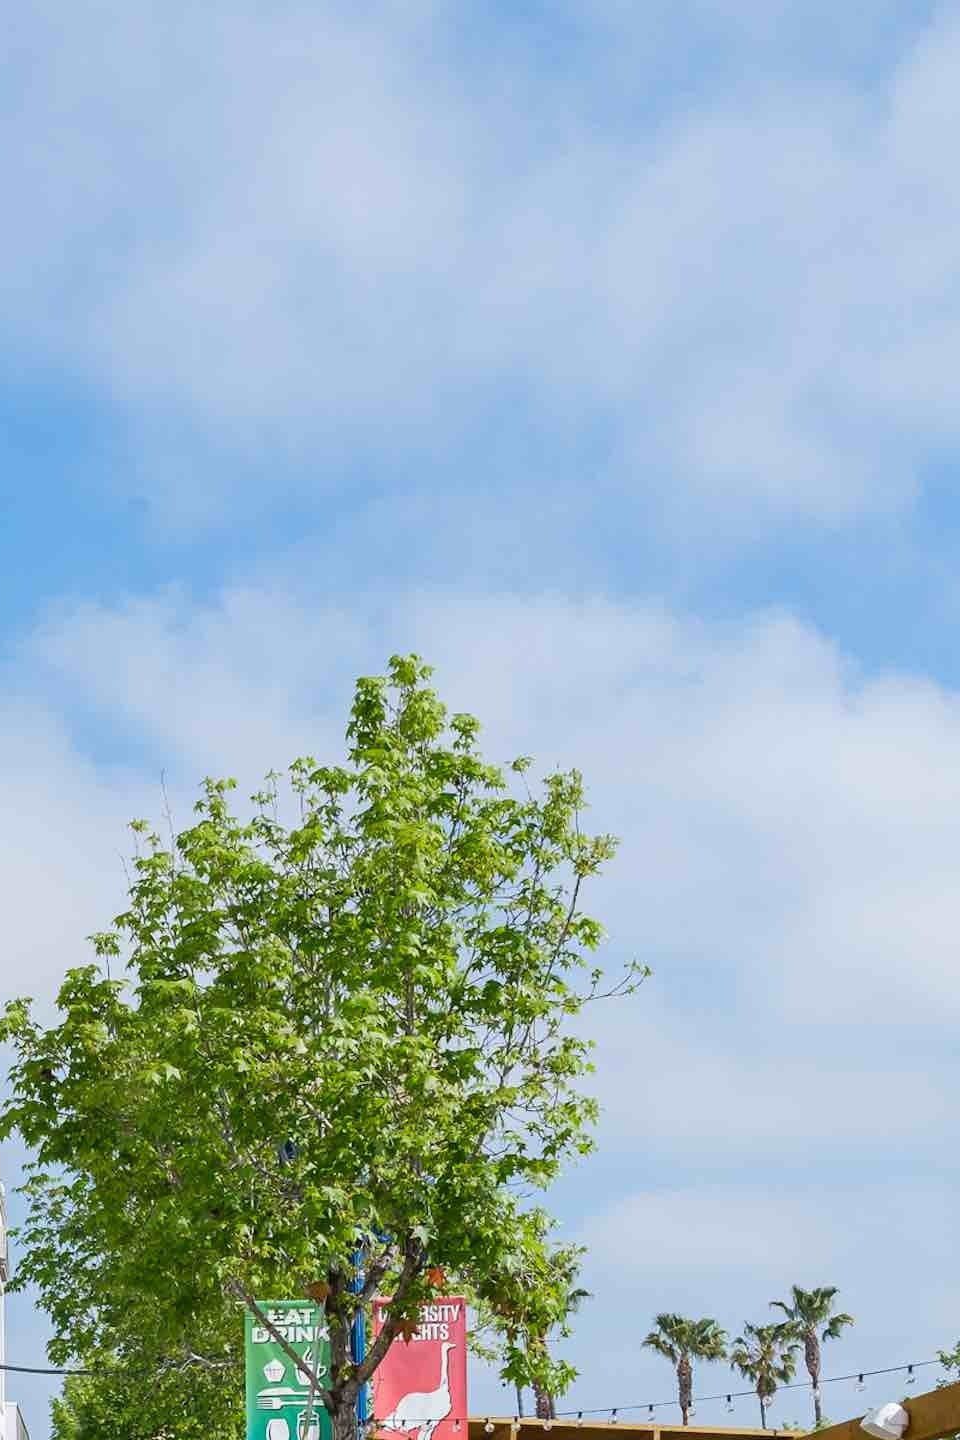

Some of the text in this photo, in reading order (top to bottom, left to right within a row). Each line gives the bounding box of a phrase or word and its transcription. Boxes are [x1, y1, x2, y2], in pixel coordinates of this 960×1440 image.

[266, 1308, 315, 1325] EAT
[378, 1304, 460, 1322] URSITY
[251, 1327, 330, 1343] DRINK
